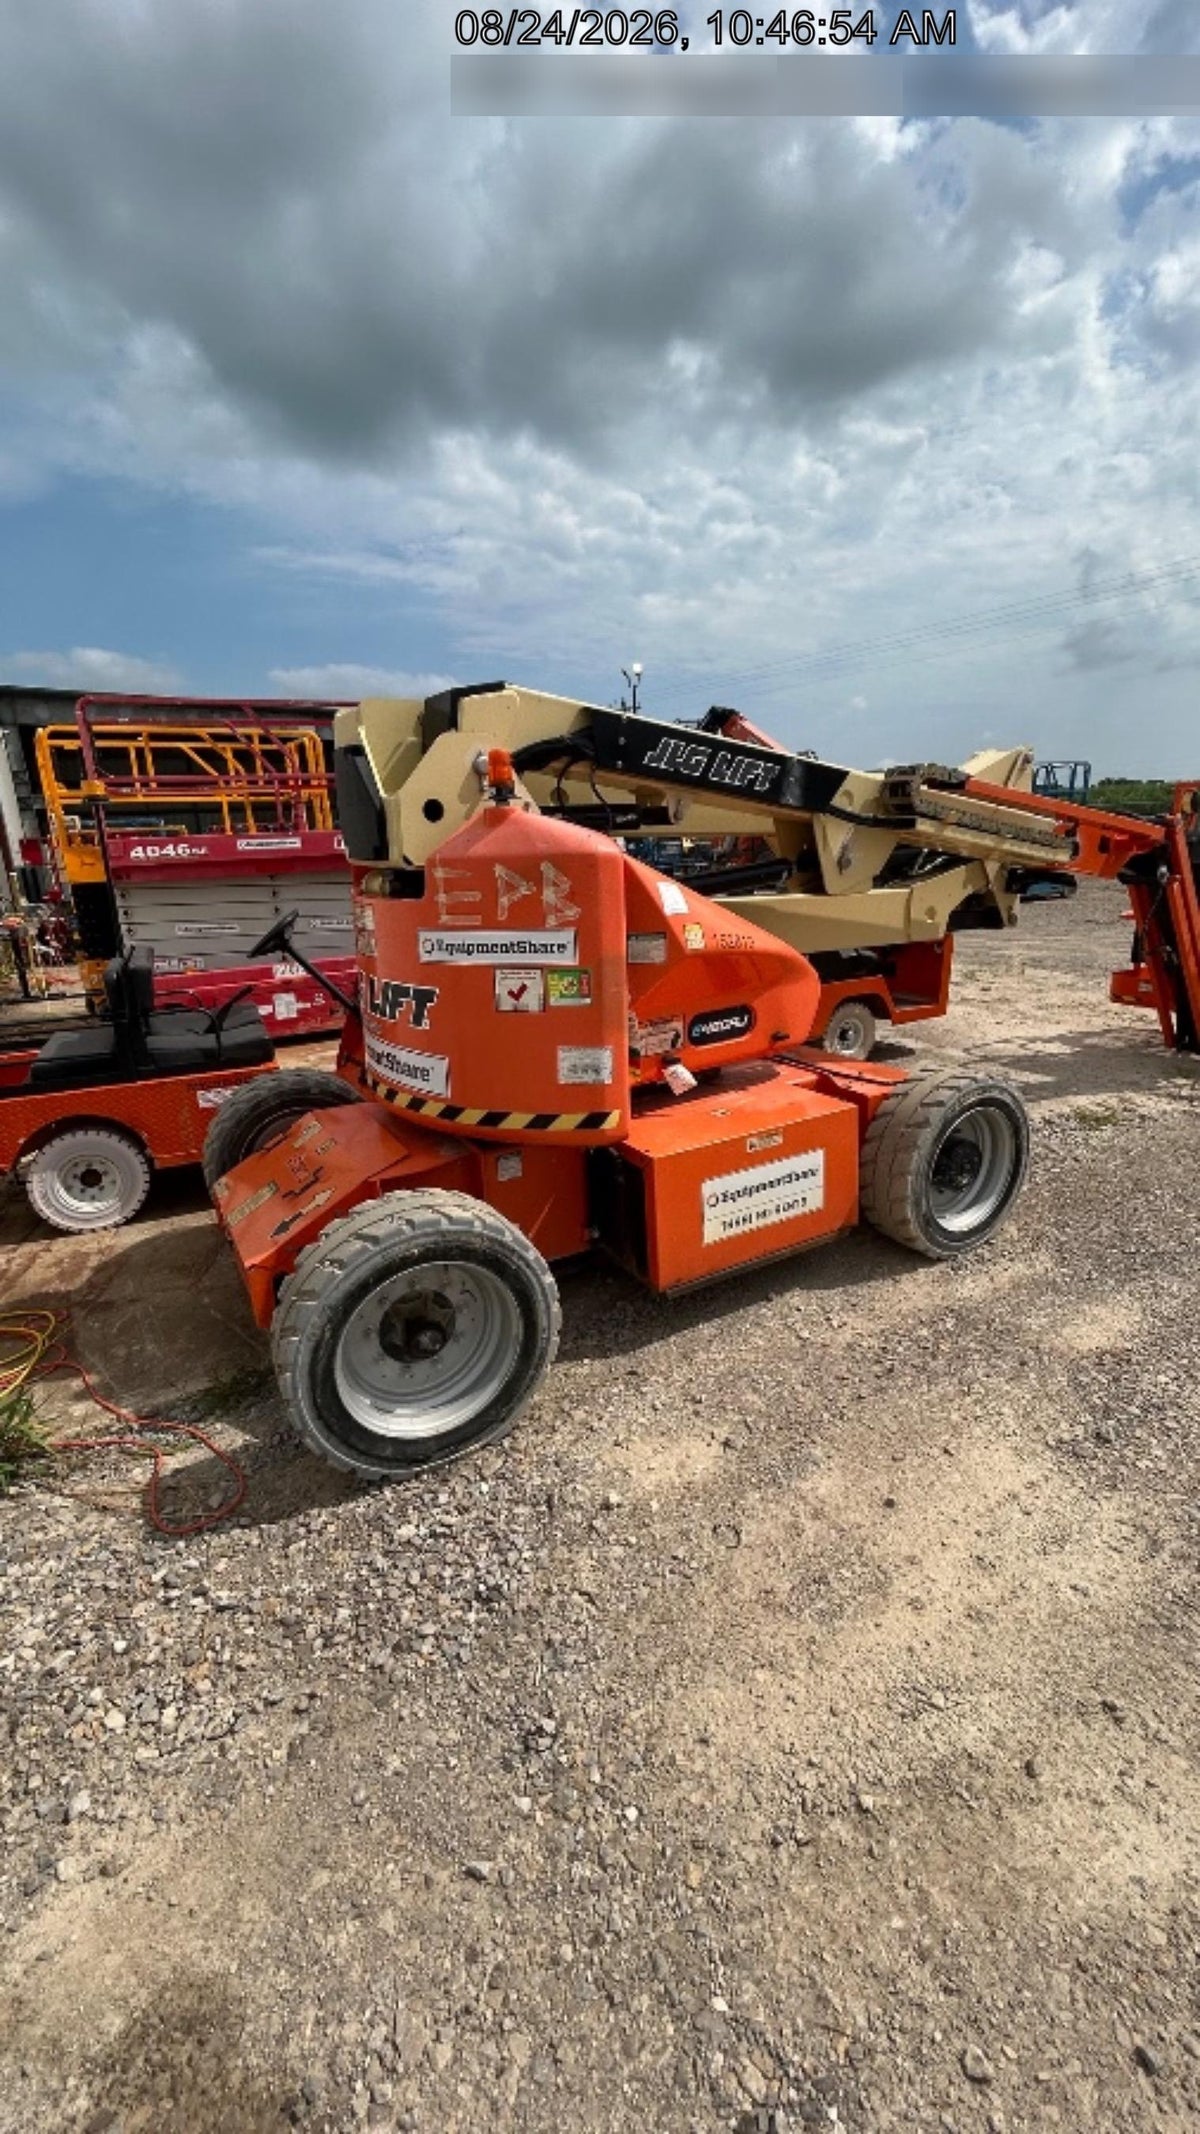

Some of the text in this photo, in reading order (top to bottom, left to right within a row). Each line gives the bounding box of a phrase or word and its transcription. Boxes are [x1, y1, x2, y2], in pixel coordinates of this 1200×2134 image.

[642, 736, 781, 792] JLG LIFT
[436, 939, 568, 957] EquipmentShare
[368, 973, 439, 1030] LIFT
